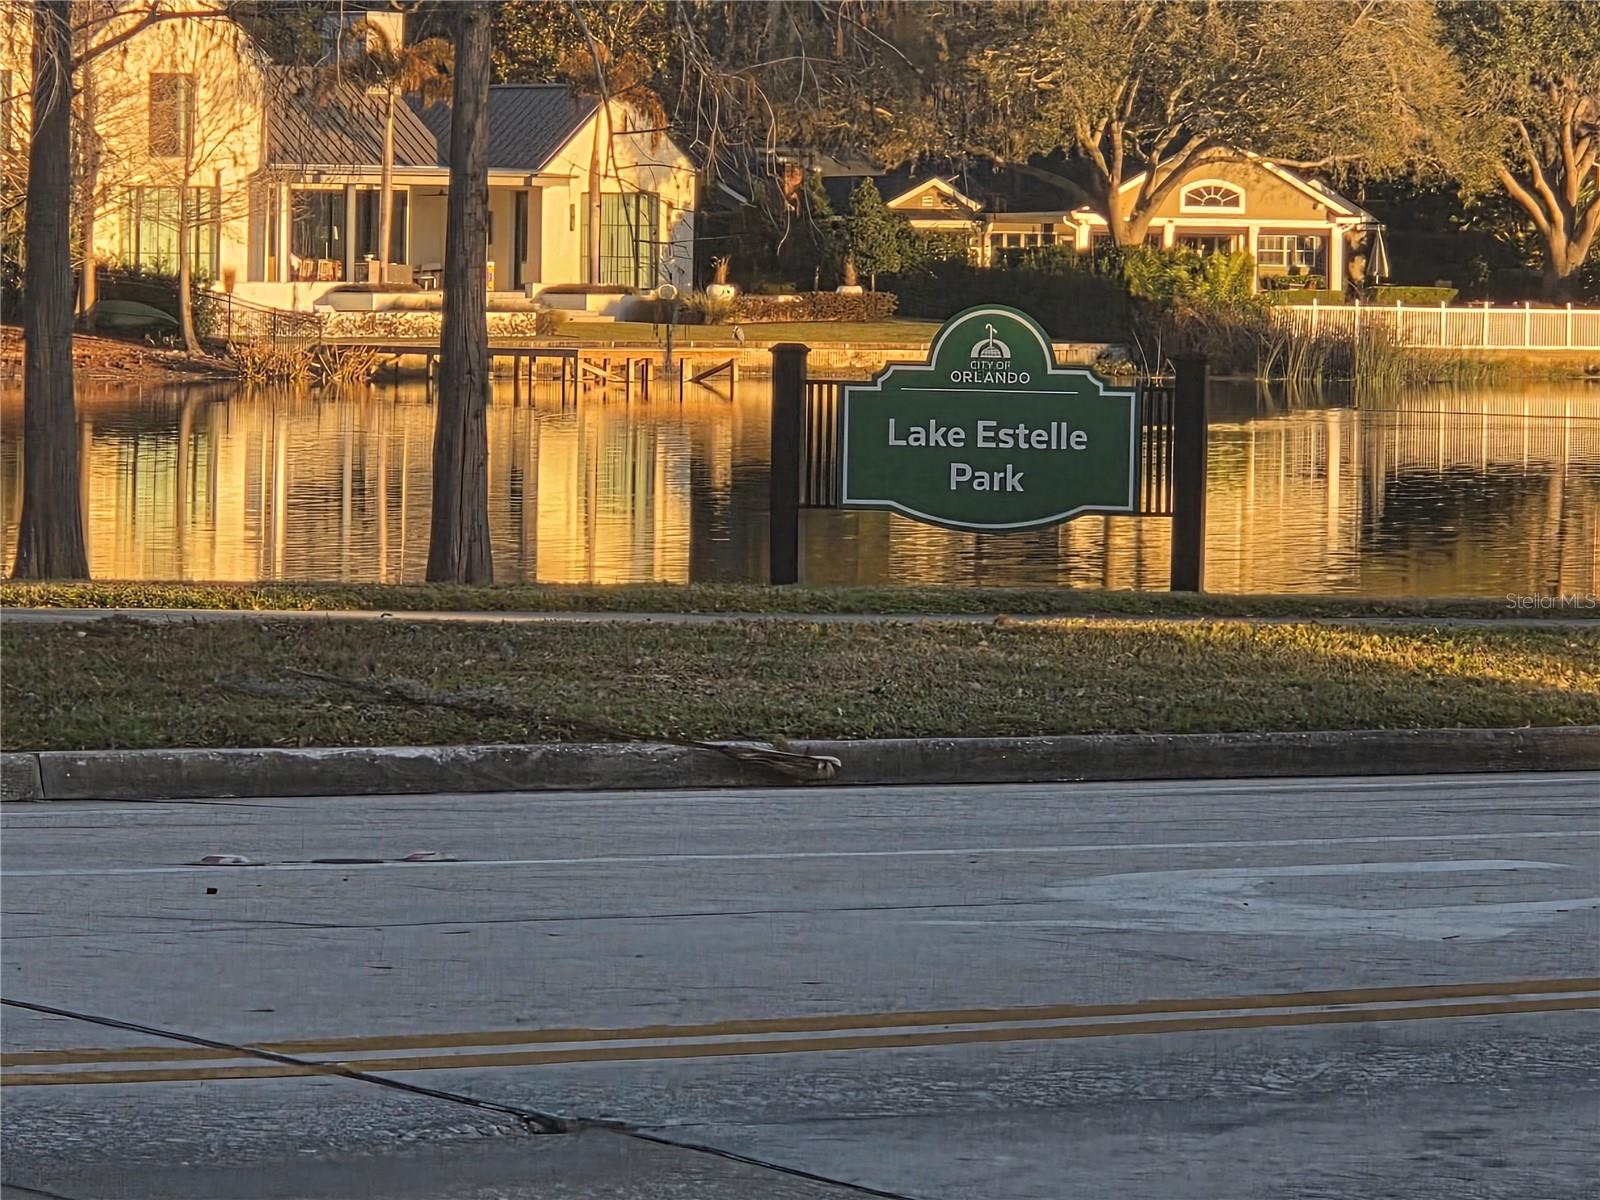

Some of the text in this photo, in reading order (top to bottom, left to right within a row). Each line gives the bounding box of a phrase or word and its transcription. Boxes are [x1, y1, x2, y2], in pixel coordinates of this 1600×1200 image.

[970, 360, 1011, 370] CITY OF
[950, 370, 1030, 384] ORLANDO
[888, 418, 1088, 450] Lake Estelle
[949, 462, 1025, 492] Park
